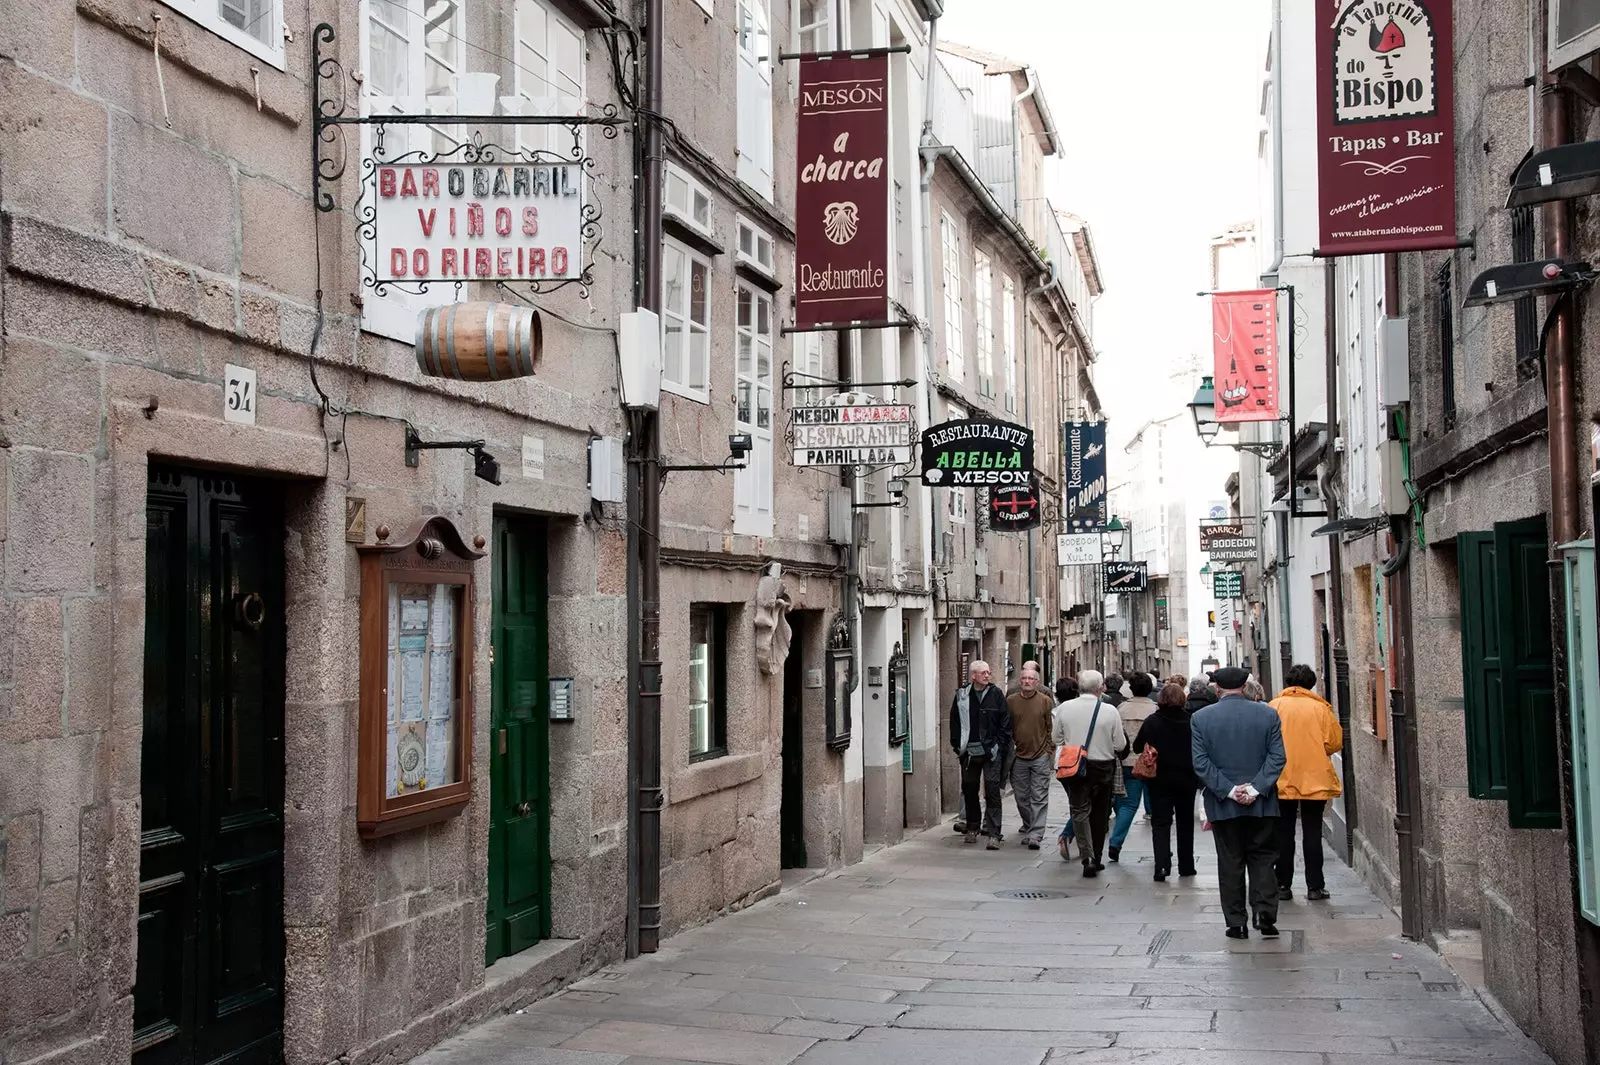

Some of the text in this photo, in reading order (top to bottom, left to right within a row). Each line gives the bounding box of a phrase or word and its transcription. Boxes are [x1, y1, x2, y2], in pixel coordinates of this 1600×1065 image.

[1343, 0, 1424, 37] a Taberna
[1346, 58, 1365, 74] do
[802, 83, 884, 107] MESÓN
[1343, 77, 1423, 110] Bispo
[833, 131, 849, 153] a
[1329, 130, 1444, 156] Tapas Bar
[801, 154, 884, 184] charca
[380, 166, 577, 197] BAR O BARRIL
[1329, 193, 1381, 216] creemos en
[1358, 205, 1369, 218] el
[1370, 202, 1393, 215] buen
[417, 202, 539, 237] VIÑOS
[1331, 224, 1443, 238] www.atabernadobispo.com
[390, 246, 568, 277] DO RIBEIRO
[800, 260, 884, 292] Restaurante
[228, 379, 251, 412] 34
[794, 407, 908, 422] MESON A CHARCA
[795, 425, 908, 447] RESTAURANTE
[928, 424, 1028, 448] RESTAURANTE
[807, 449, 896, 464] PARRILLADA
[1068, 428, 1081, 489] Restaurante
[953, 470, 1030, 484] MESON
[1212, 538, 1256, 548] BODEGON
